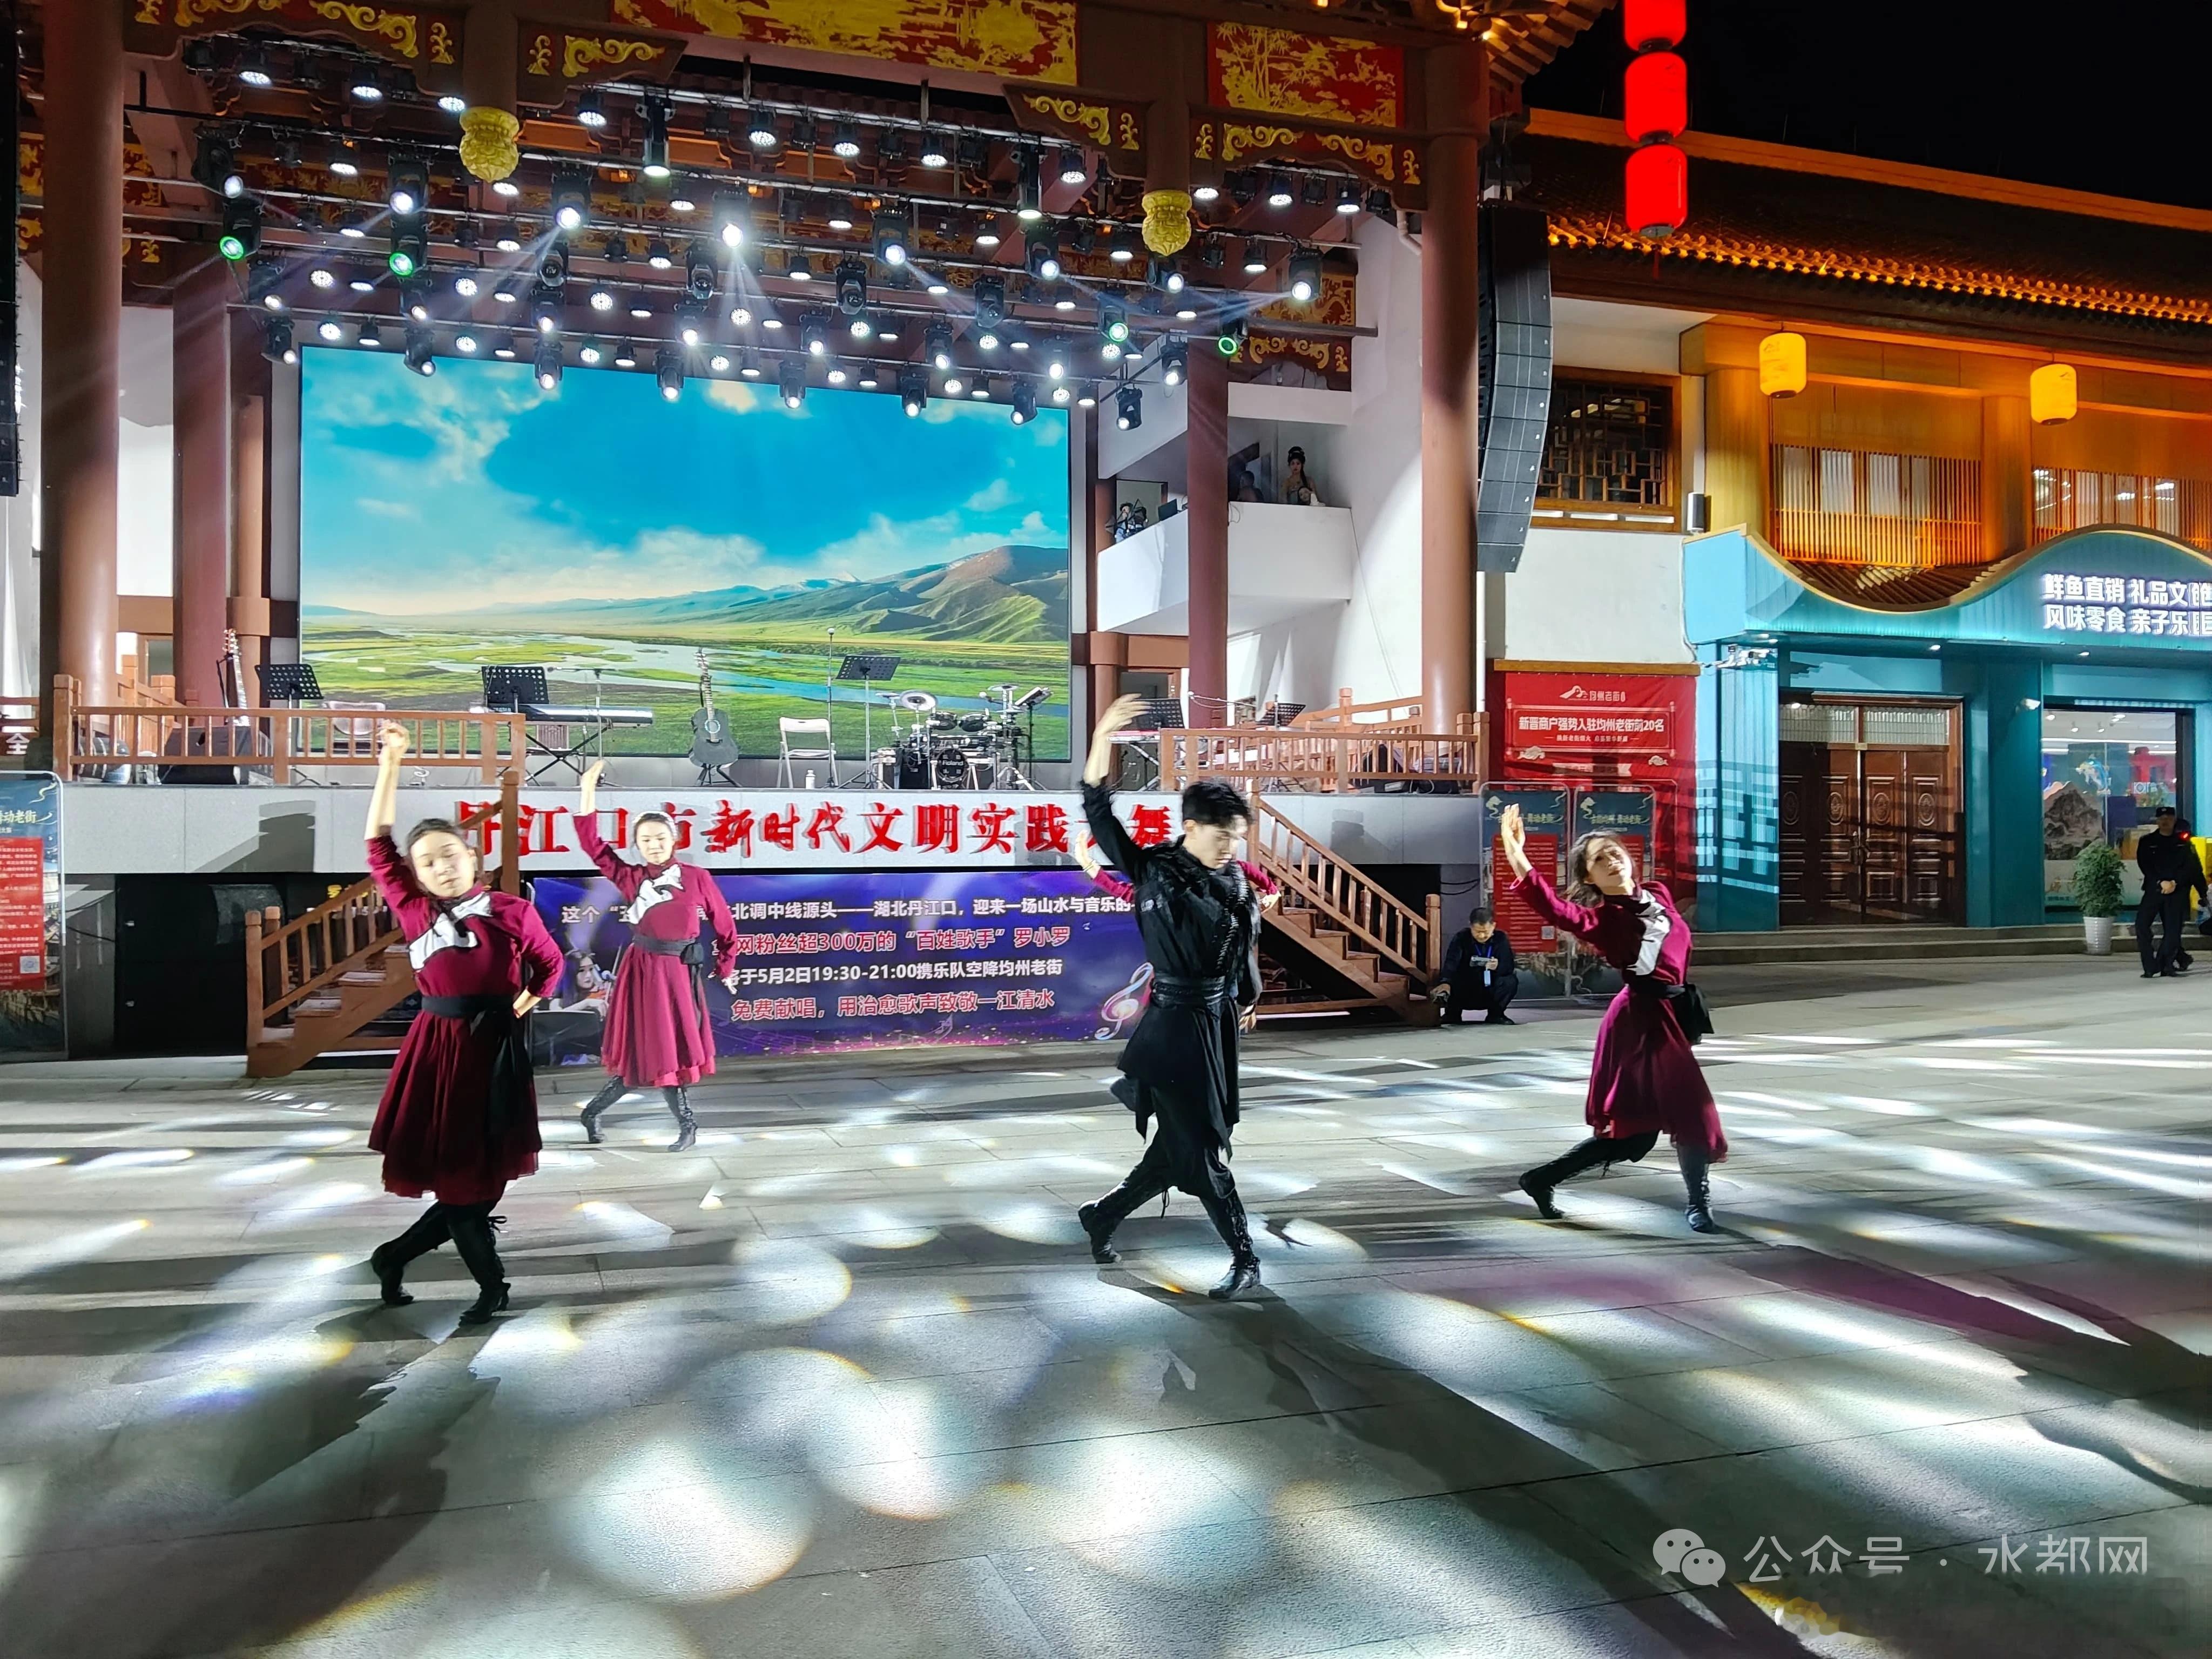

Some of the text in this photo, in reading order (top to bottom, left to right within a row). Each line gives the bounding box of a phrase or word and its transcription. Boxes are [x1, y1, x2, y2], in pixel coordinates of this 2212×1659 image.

[2043, 574, 2126, 603] 鲜鱼直销
[2044, 604, 2127, 632] 风味零食
[1519, 716, 1664, 732] 新晋商户强势入驻均州老街前20名
[6, 733, 30, 754] 全
